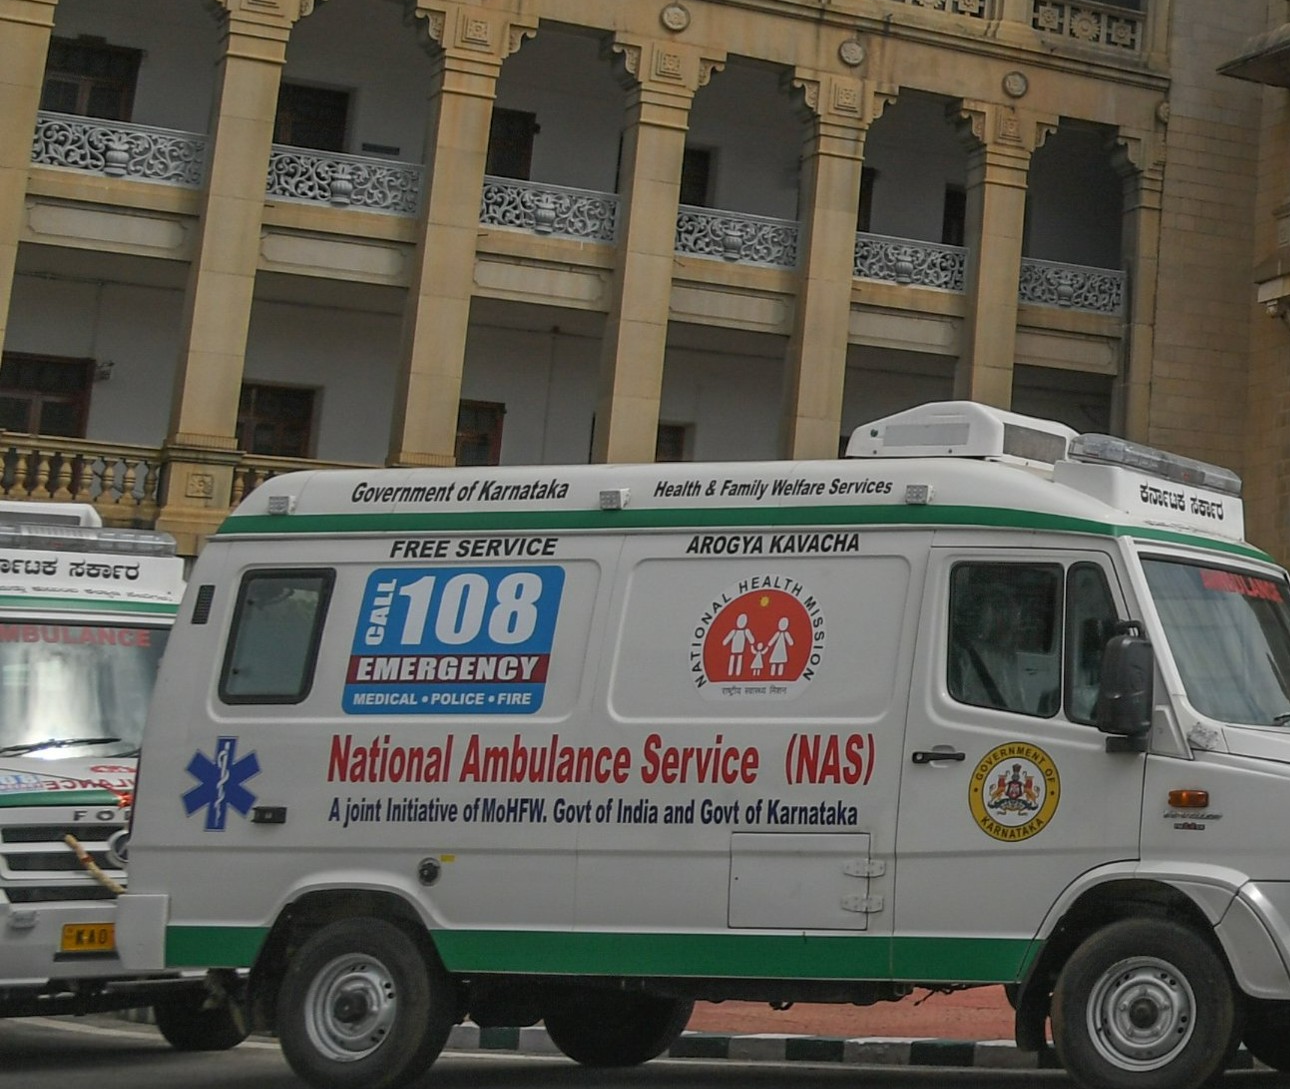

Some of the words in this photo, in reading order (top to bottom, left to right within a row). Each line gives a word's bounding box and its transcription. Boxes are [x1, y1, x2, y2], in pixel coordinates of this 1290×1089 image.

[352, 481, 455, 502] Government
[457, 480, 479, 501] of
[478, 479, 569, 501] Karnataka
[654, 480, 701, 498] Health
[705, 480, 717, 496] &
[720, 479, 768, 500] Family
[772, 478, 825, 497] Welfare
[829, 478, 893, 495] Services
[390, 540, 450, 558] FREE
[456, 538, 558, 557] SERVICE
[686, 535, 763, 554] AROGYA
[769, 533, 859, 553] KAVACHA
[69, 560, 140, 580] ಸರ್ಕಾರ
[365, 579, 397, 645] CALL
[399, 573, 543, 645] 108
[0, 625, 151, 646] MBULANCE
[690, 593, 732, 688] NATIONAL
[739, 575, 803, 596] HEALTH
[803, 596, 825, 681] MISSION
[356, 656, 539, 681] EMERGENCY
[353, 693, 417, 705] MEDICAL
[431, 693, 484, 705] POLICE
[497, 693, 532, 705] FIRE
[327, 734, 454, 783] National
[459, 734, 631, 783] Ambulance
[641, 733, 759, 784] Service
[785, 733, 876, 785] (NAS)
[976, 746, 1046, 781] GOVERNMENT
[1045, 768, 1055, 783] OF
[328, 797, 340, 822] A
[343, 797, 382, 828] joint
[386, 797, 458, 822] Initiative
[463, 797, 480, 822] of
[481, 798, 547, 823] MoHFW.
[553, 798, 592, 823] Govt
[595, 798, 613, 823] of
[617, 798, 658, 824] India
[663, 799, 695, 824] and
[701, 799, 740, 825] Govt
[746, 799, 763, 825] of
[767, 799, 858, 825] Karnataka
[981, 817, 1044, 839] KARNATAKA
